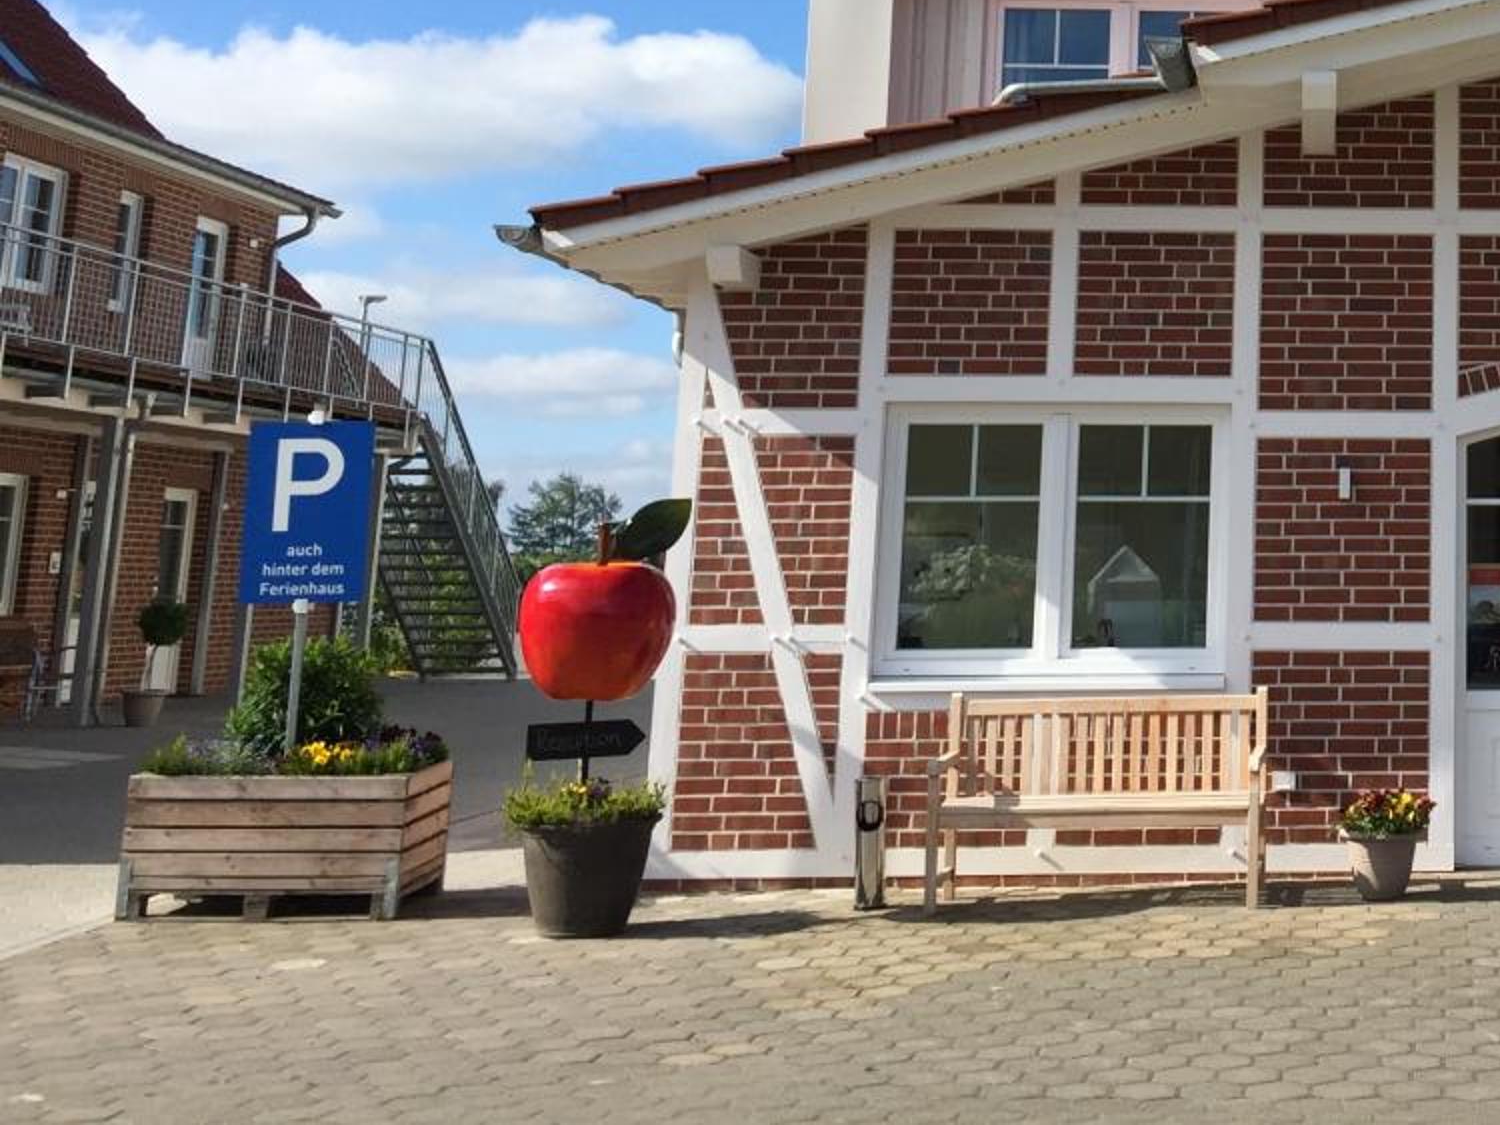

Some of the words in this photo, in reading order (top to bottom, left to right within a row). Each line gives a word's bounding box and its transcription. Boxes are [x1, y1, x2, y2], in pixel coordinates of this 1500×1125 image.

[272, 438, 345, 532] P
[286, 542, 323, 557] auch
[262, 562, 309, 577] hinter
[311, 562, 345, 576] dem
[259, 581, 345, 596] Ferienhaus
